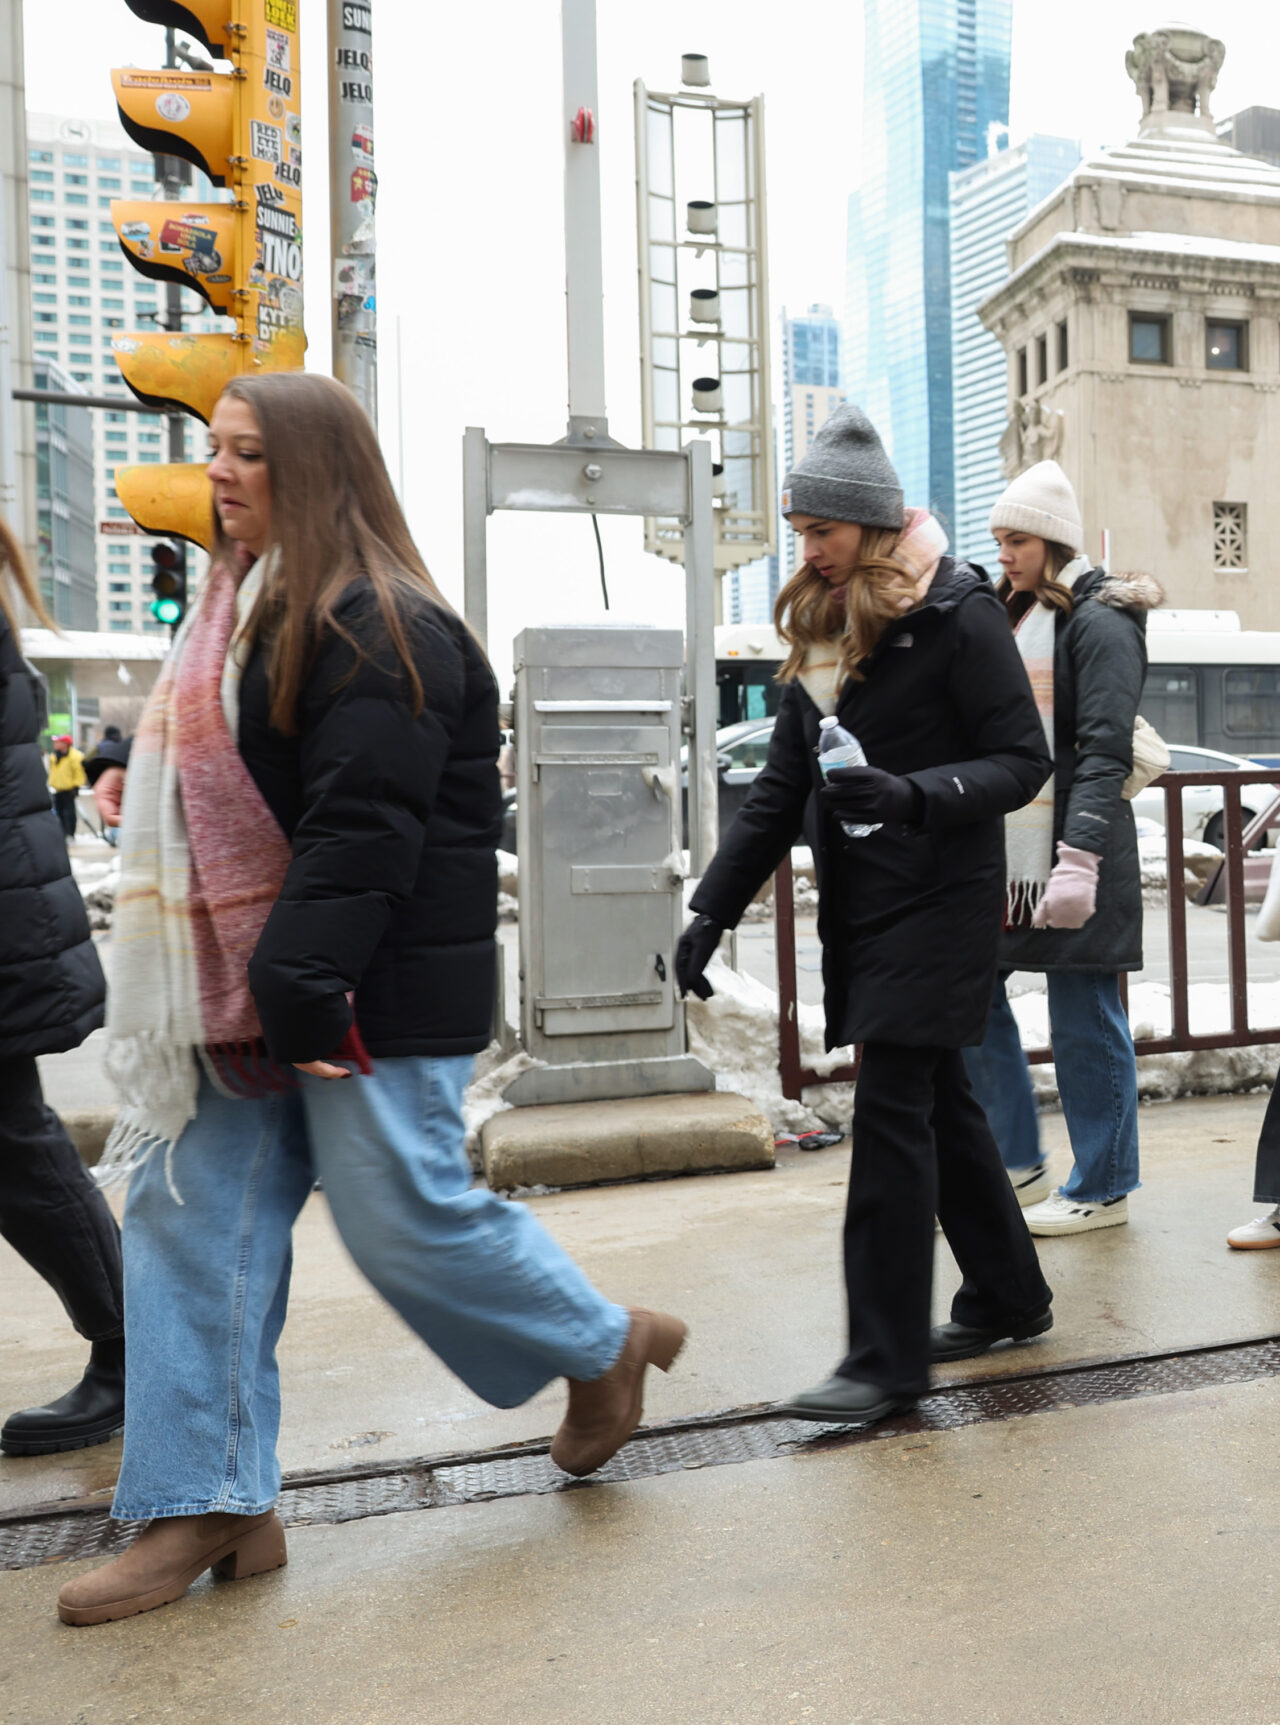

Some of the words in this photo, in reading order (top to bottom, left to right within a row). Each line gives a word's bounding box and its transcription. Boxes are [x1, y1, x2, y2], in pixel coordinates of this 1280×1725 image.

[337, 48, 370, 72] JELQ
[264, 68, 291, 96] JELQ
[275, 161, 301, 185] JELQ
[257, 205, 295, 236] SUNNIE
[263, 231, 301, 280] TNO
